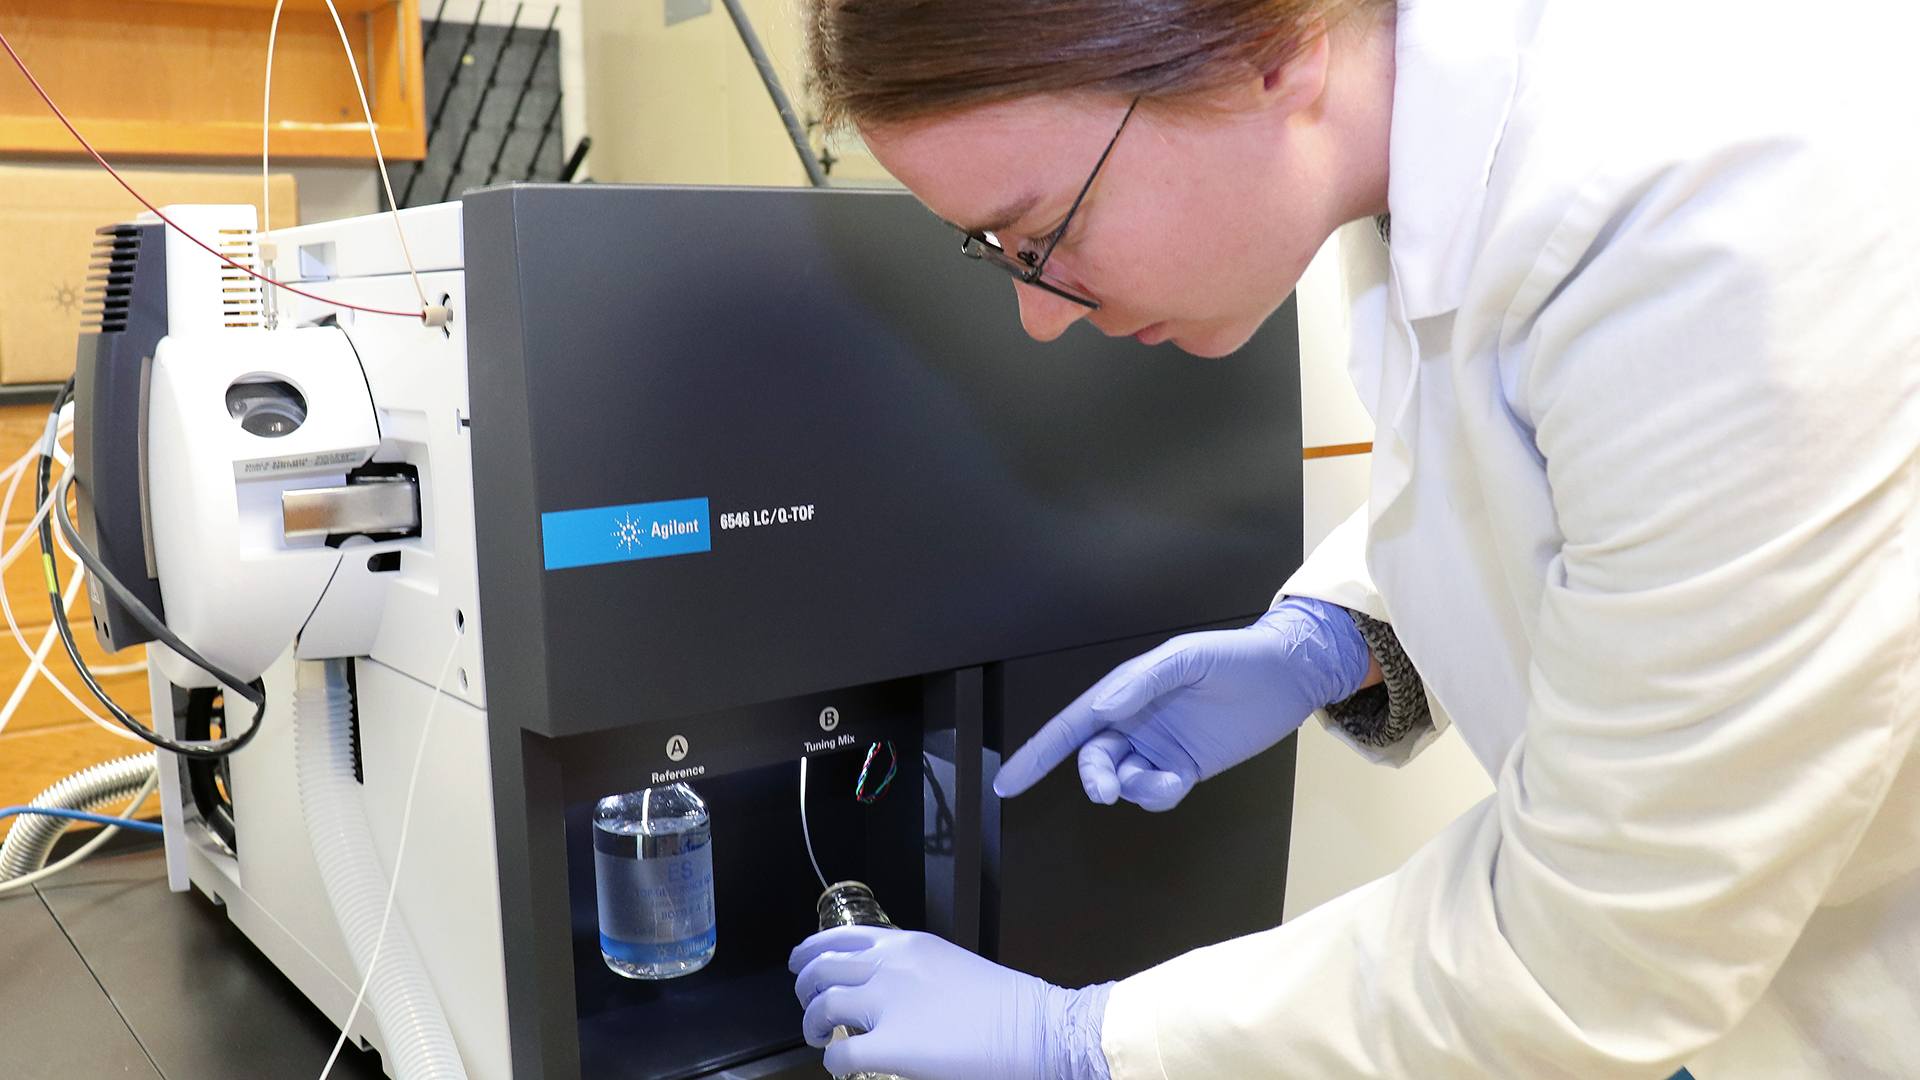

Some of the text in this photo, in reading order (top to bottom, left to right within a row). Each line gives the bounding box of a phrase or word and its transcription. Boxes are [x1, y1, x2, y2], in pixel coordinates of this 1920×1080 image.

[720, 505, 815, 530] 6546 LC/Q-TOF
[651, 519, 700, 540] Agilent
[824, 711, 836, 727] B
[670, 739, 684, 756] A
[804, 734, 856, 753] Tuning Mix
[651, 765, 705, 784] Reference
[669, 861, 693, 882] ES
[676, 938, 708, 956] Agilent
